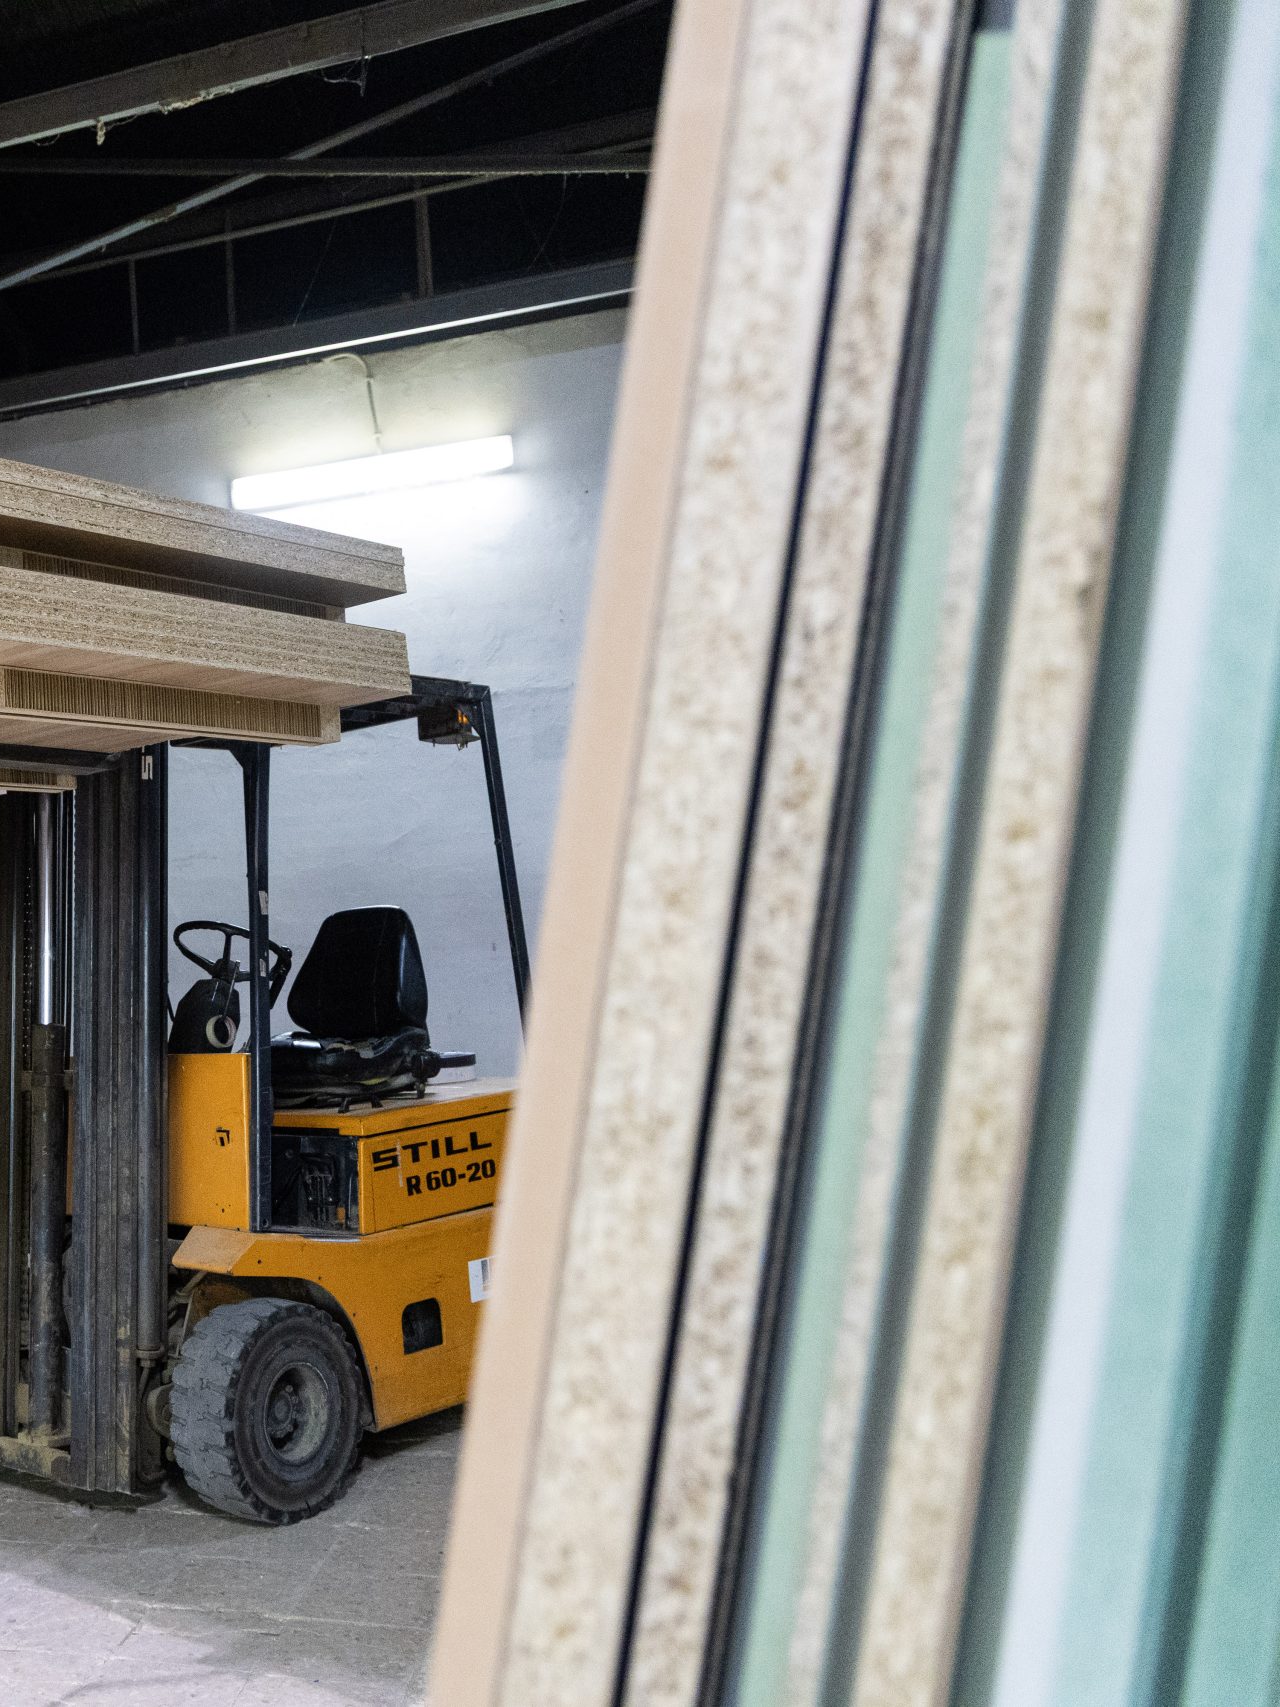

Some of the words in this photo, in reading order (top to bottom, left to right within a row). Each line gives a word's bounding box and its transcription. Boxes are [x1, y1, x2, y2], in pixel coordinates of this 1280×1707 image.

[372, 1131, 492, 1172] STILL
[406, 1175, 423, 1197] R
[427, 1158, 496, 1192] 60-20
